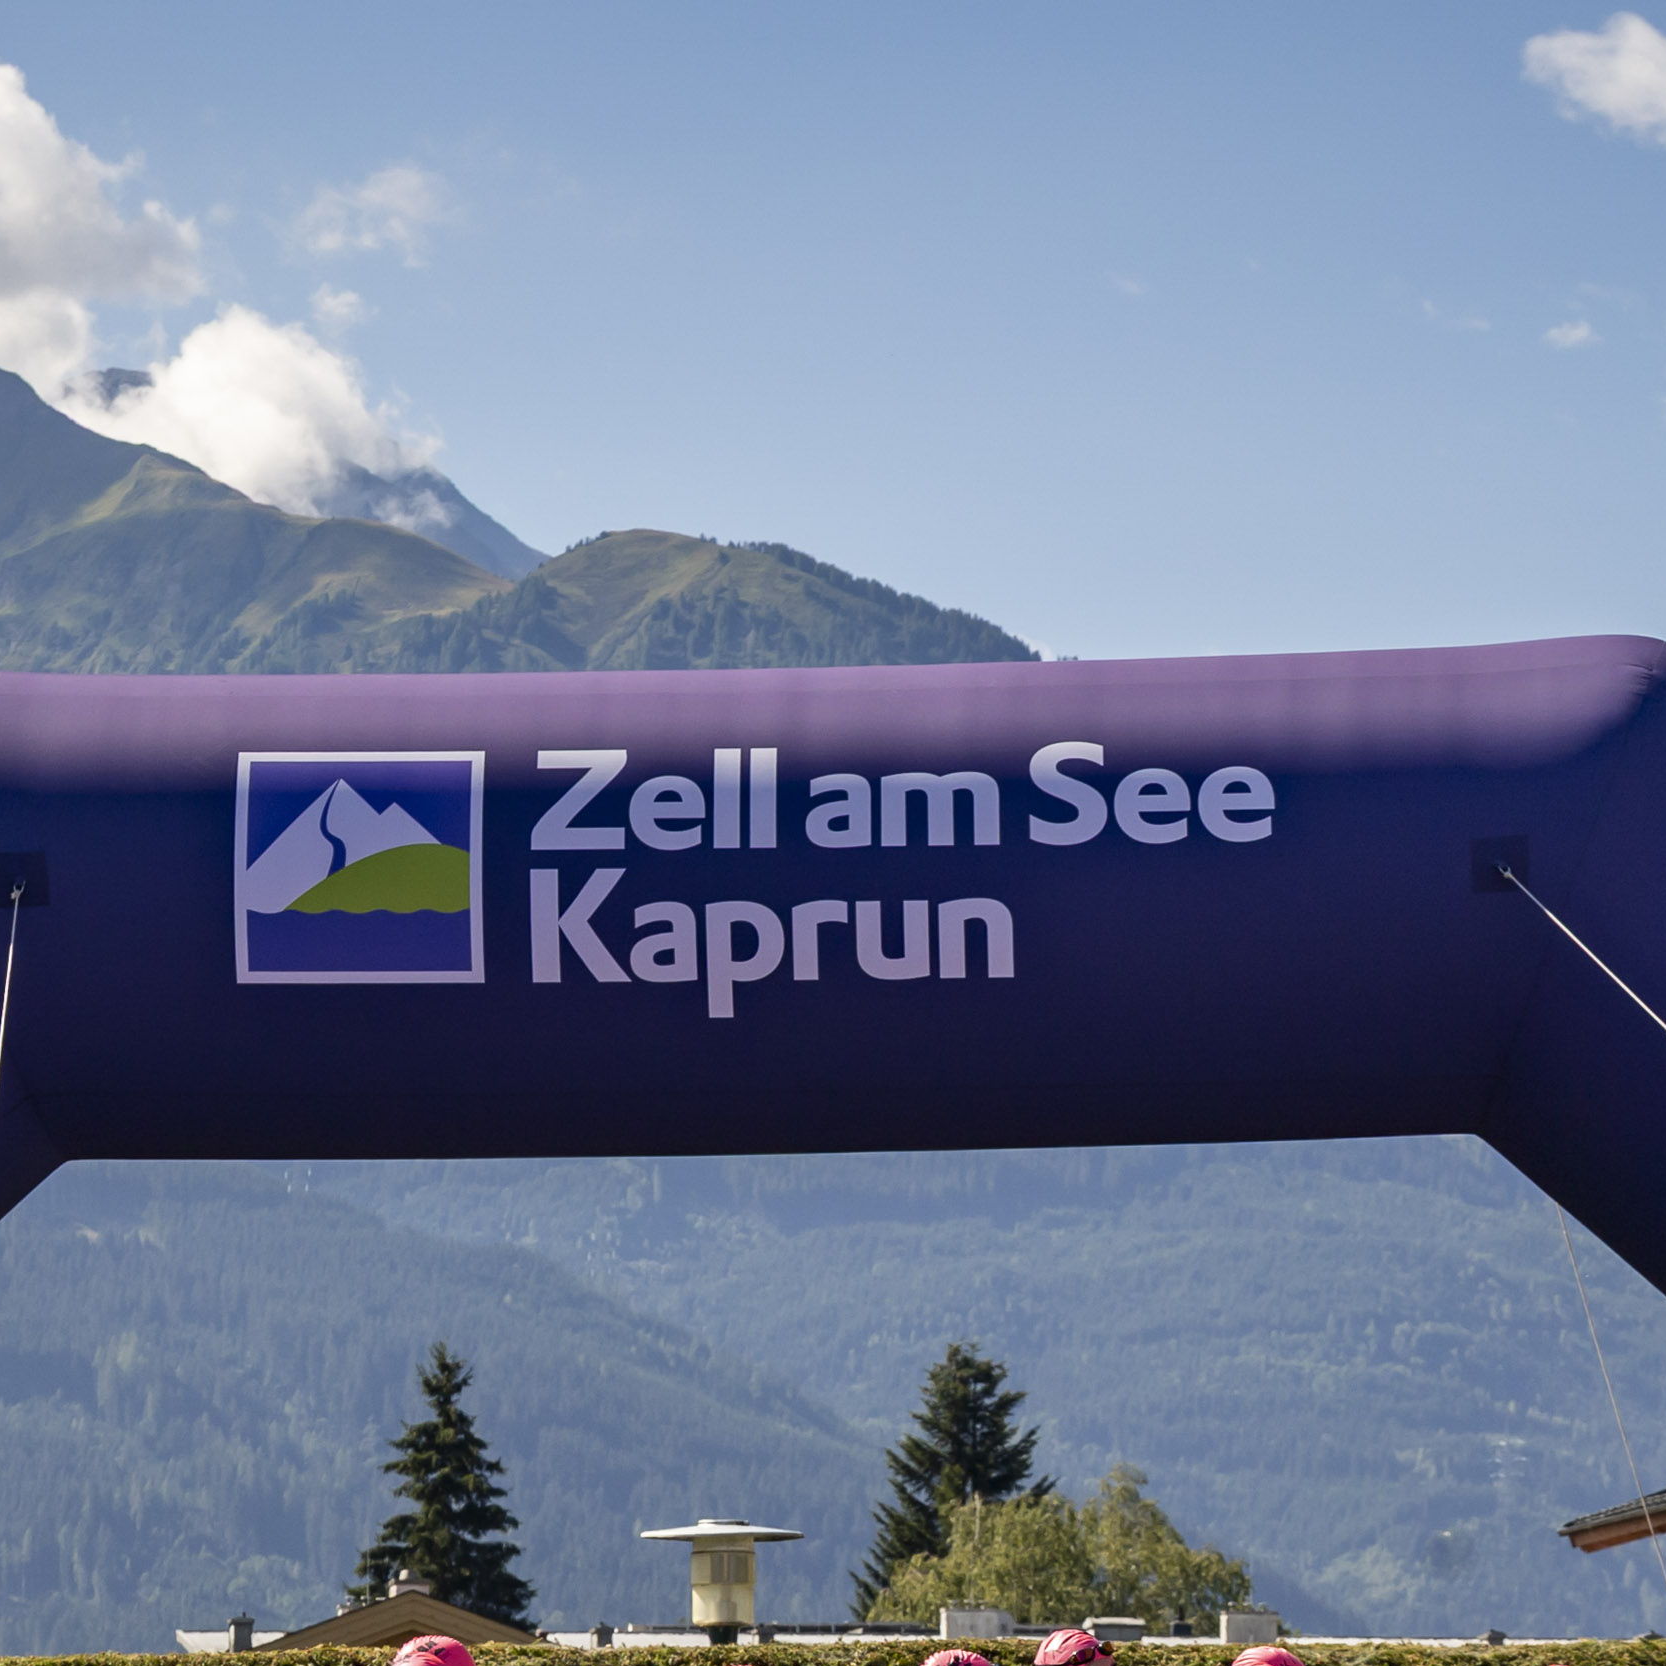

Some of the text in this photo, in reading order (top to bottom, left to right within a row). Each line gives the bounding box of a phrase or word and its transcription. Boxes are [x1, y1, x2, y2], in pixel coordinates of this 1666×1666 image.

[531, 740, 1277, 851] Zell am See
[530, 866, 1016, 1019] Kaprun
